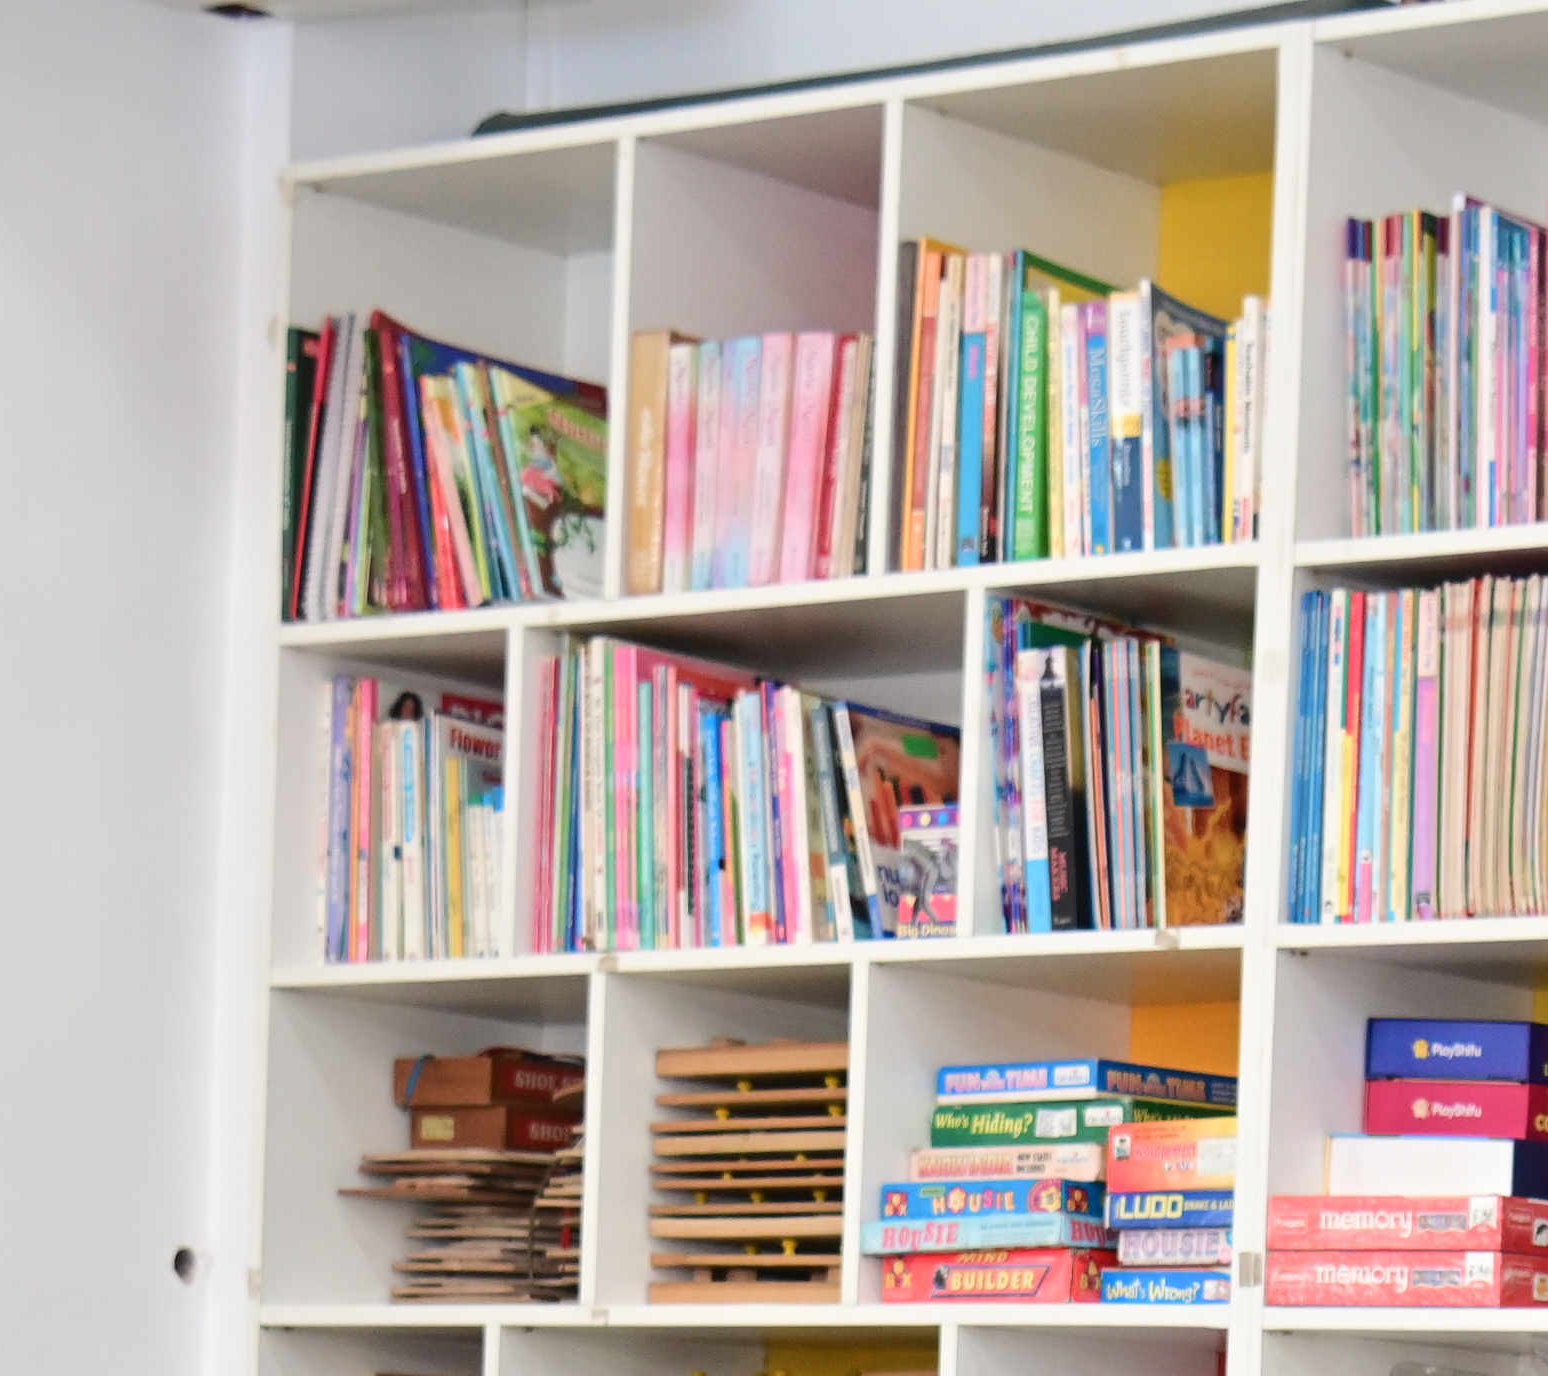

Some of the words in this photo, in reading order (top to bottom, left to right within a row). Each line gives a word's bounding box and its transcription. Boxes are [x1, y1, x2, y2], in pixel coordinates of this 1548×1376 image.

[1023, 314, 1040, 373] CHILD
[1017, 374, 1039, 513] DEVELOPMENT
[1431, 1043, 1482, 1059] PlayShifu
[1431, 1104, 1482, 1119] PlayShifu
[934, 1113, 970, 1129] Who's
[970, 1112, 1034, 1138] Hiding?
[1120, 1194, 1184, 1219] LUDO
[882, 1223, 959, 1251] HOUSIE
[1319, 1209, 1414, 1239] memory
[951, 1269, 1035, 1291] BUILDER
